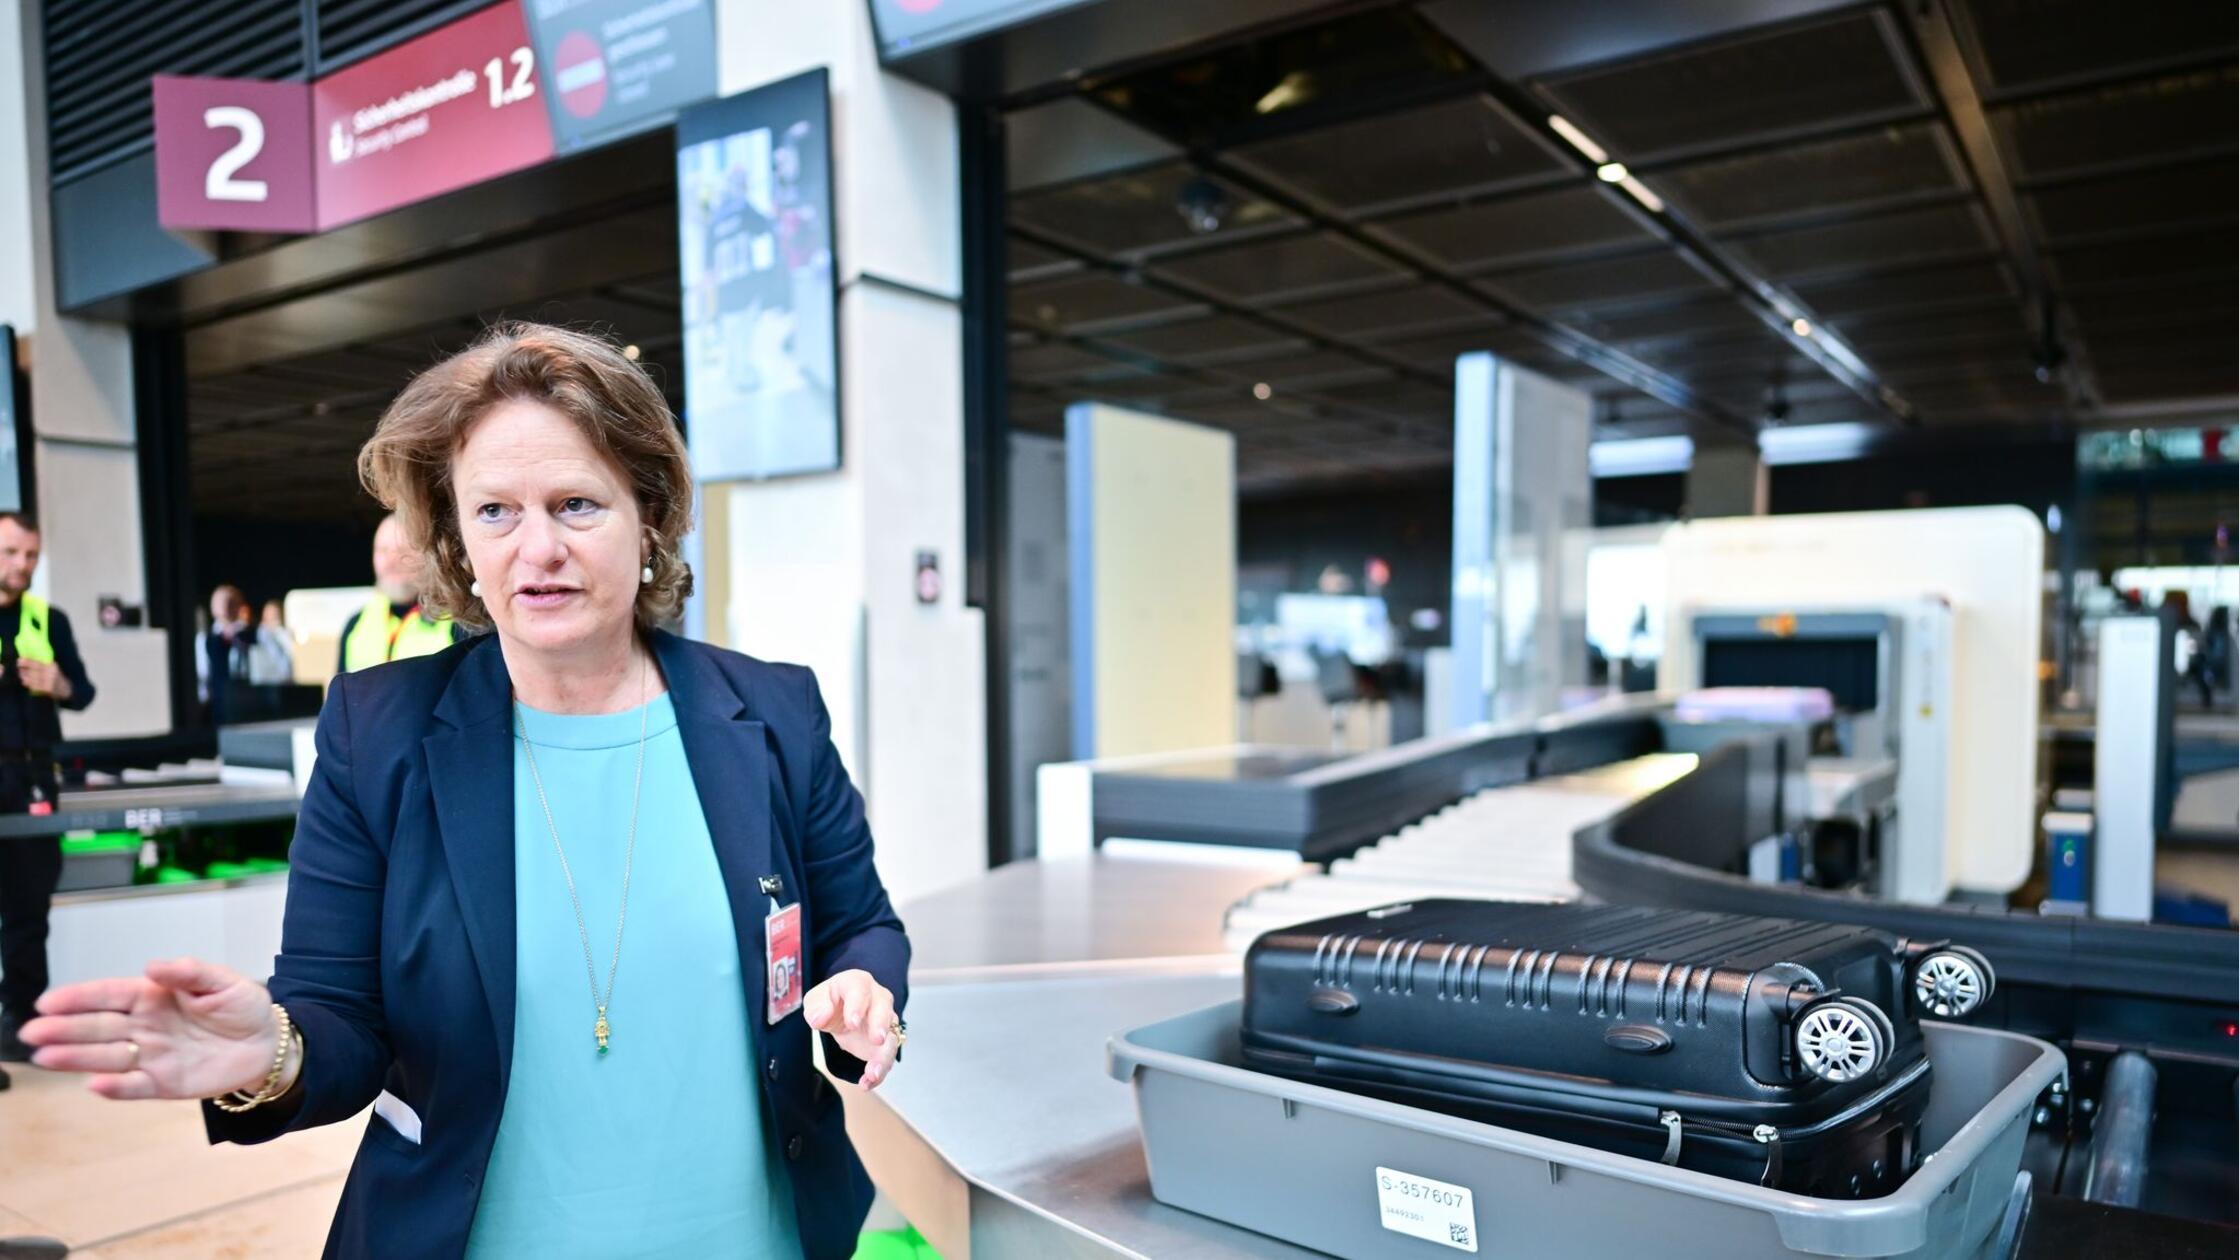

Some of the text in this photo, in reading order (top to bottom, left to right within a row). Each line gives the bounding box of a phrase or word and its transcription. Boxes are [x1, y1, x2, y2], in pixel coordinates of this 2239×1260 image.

[484, 47, 535, 108] 1.2
[204, 106, 267, 201] 2
[125, 808, 161, 828] BER
[1381, 1176, 1463, 1207] S-357607
